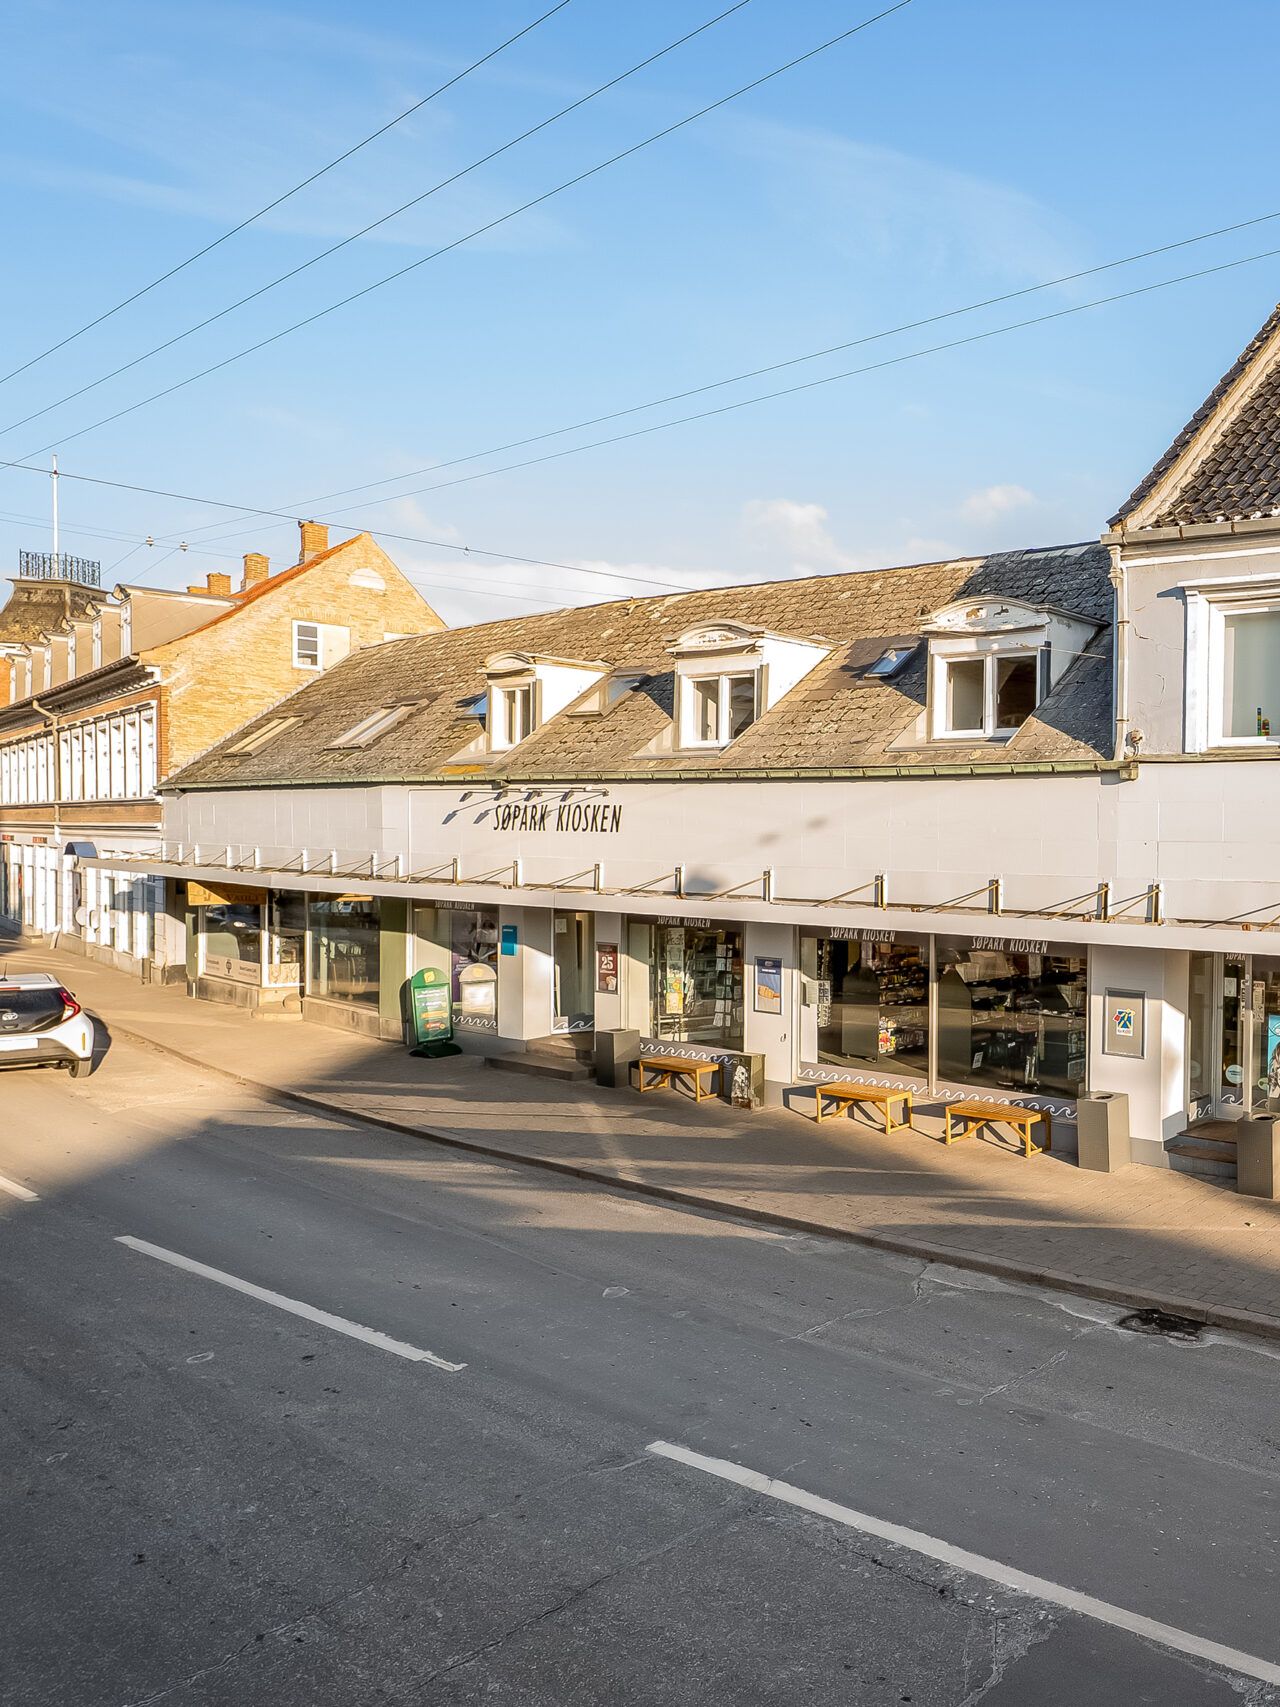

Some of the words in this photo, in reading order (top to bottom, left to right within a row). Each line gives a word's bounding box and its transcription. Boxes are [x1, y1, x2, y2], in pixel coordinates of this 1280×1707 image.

[493, 804, 548, 831] SØPARK
[556, 804, 622, 832] KIOSKEN
[830, 927, 858, 940] SØPARK
[862, 929, 896, 943] KIOSKEN
[971, 936, 1005, 951] SØPARK
[1009, 939, 1049, 954] KIOSKEN
[601, 956, 614, 970] 25
